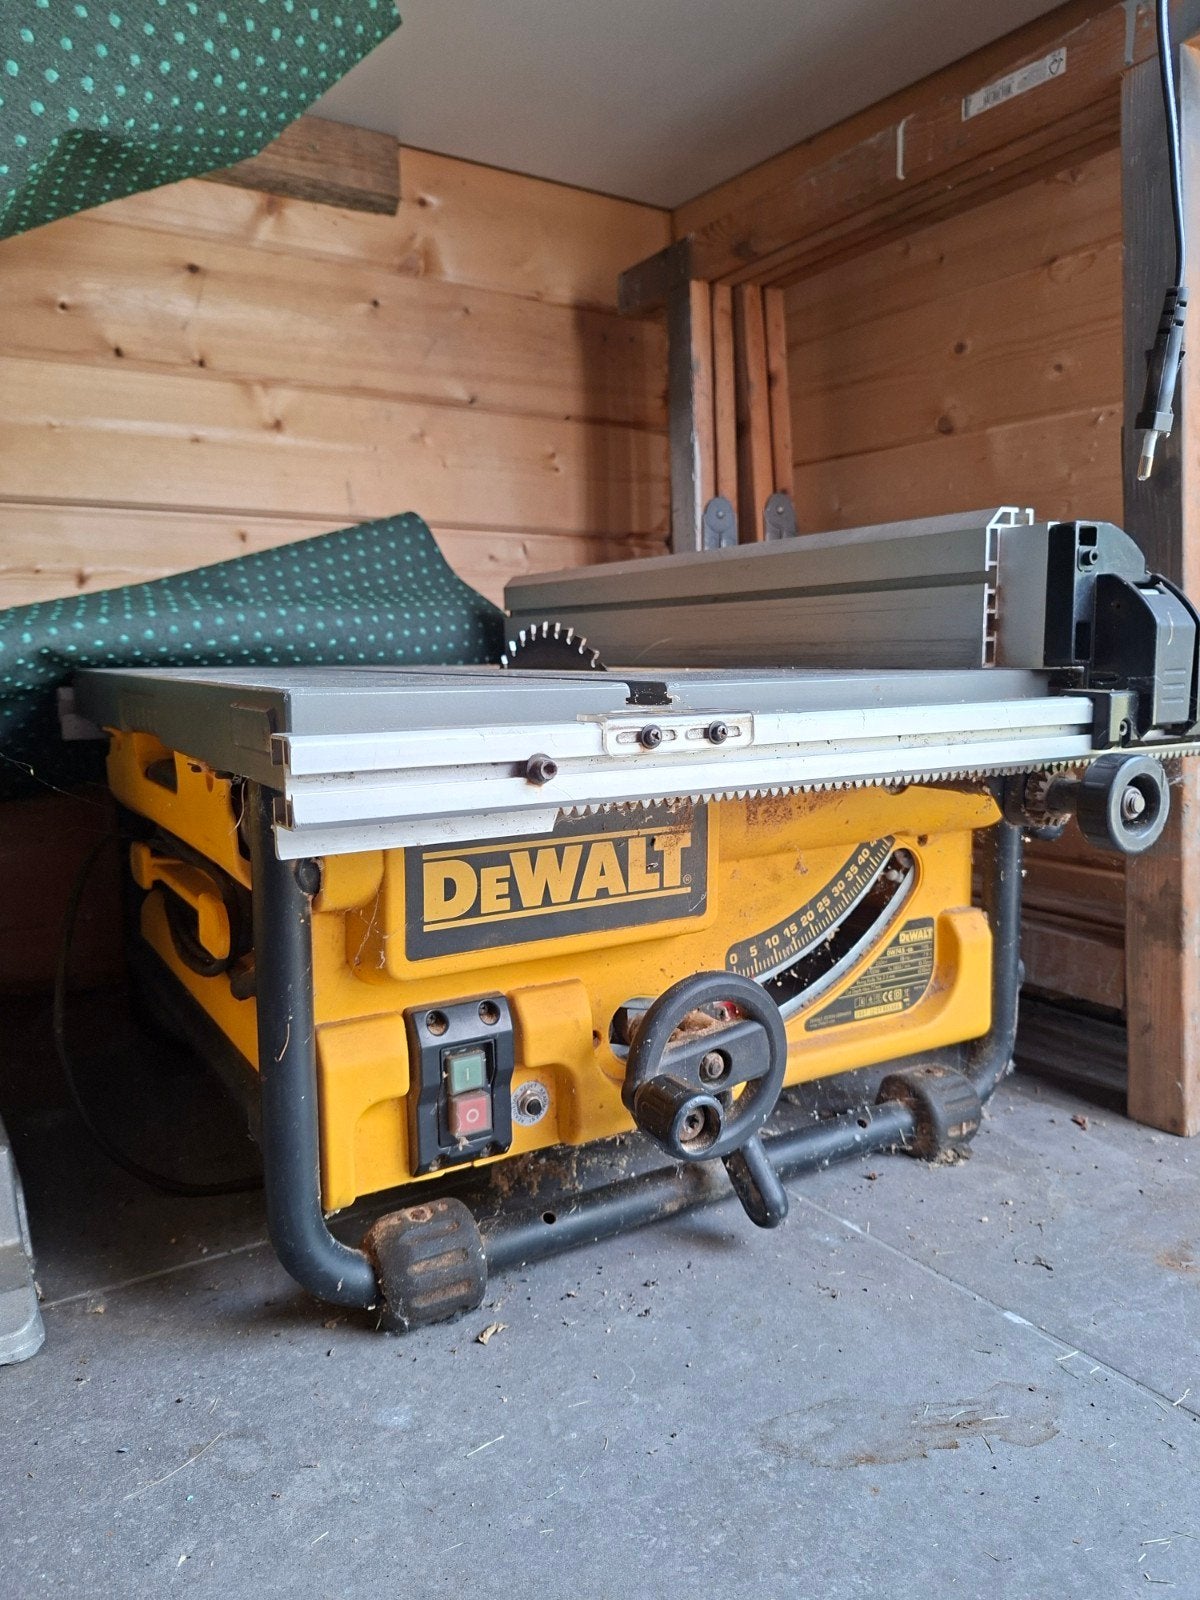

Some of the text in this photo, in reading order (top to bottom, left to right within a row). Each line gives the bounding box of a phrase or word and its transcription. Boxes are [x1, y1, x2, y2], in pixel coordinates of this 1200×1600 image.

[729, 953, 738, 965] 0
[749, 945, 758, 958] 5
[765, 934, 780, 949] 10
[783, 923, 798, 938] 15
[800, 910, 815, 927] 20
[816, 895, 831, 913] 25
[831, 880, 846, 897] 30
[845, 864, 859, 882] 35
[857, 848, 870, 865] 40
